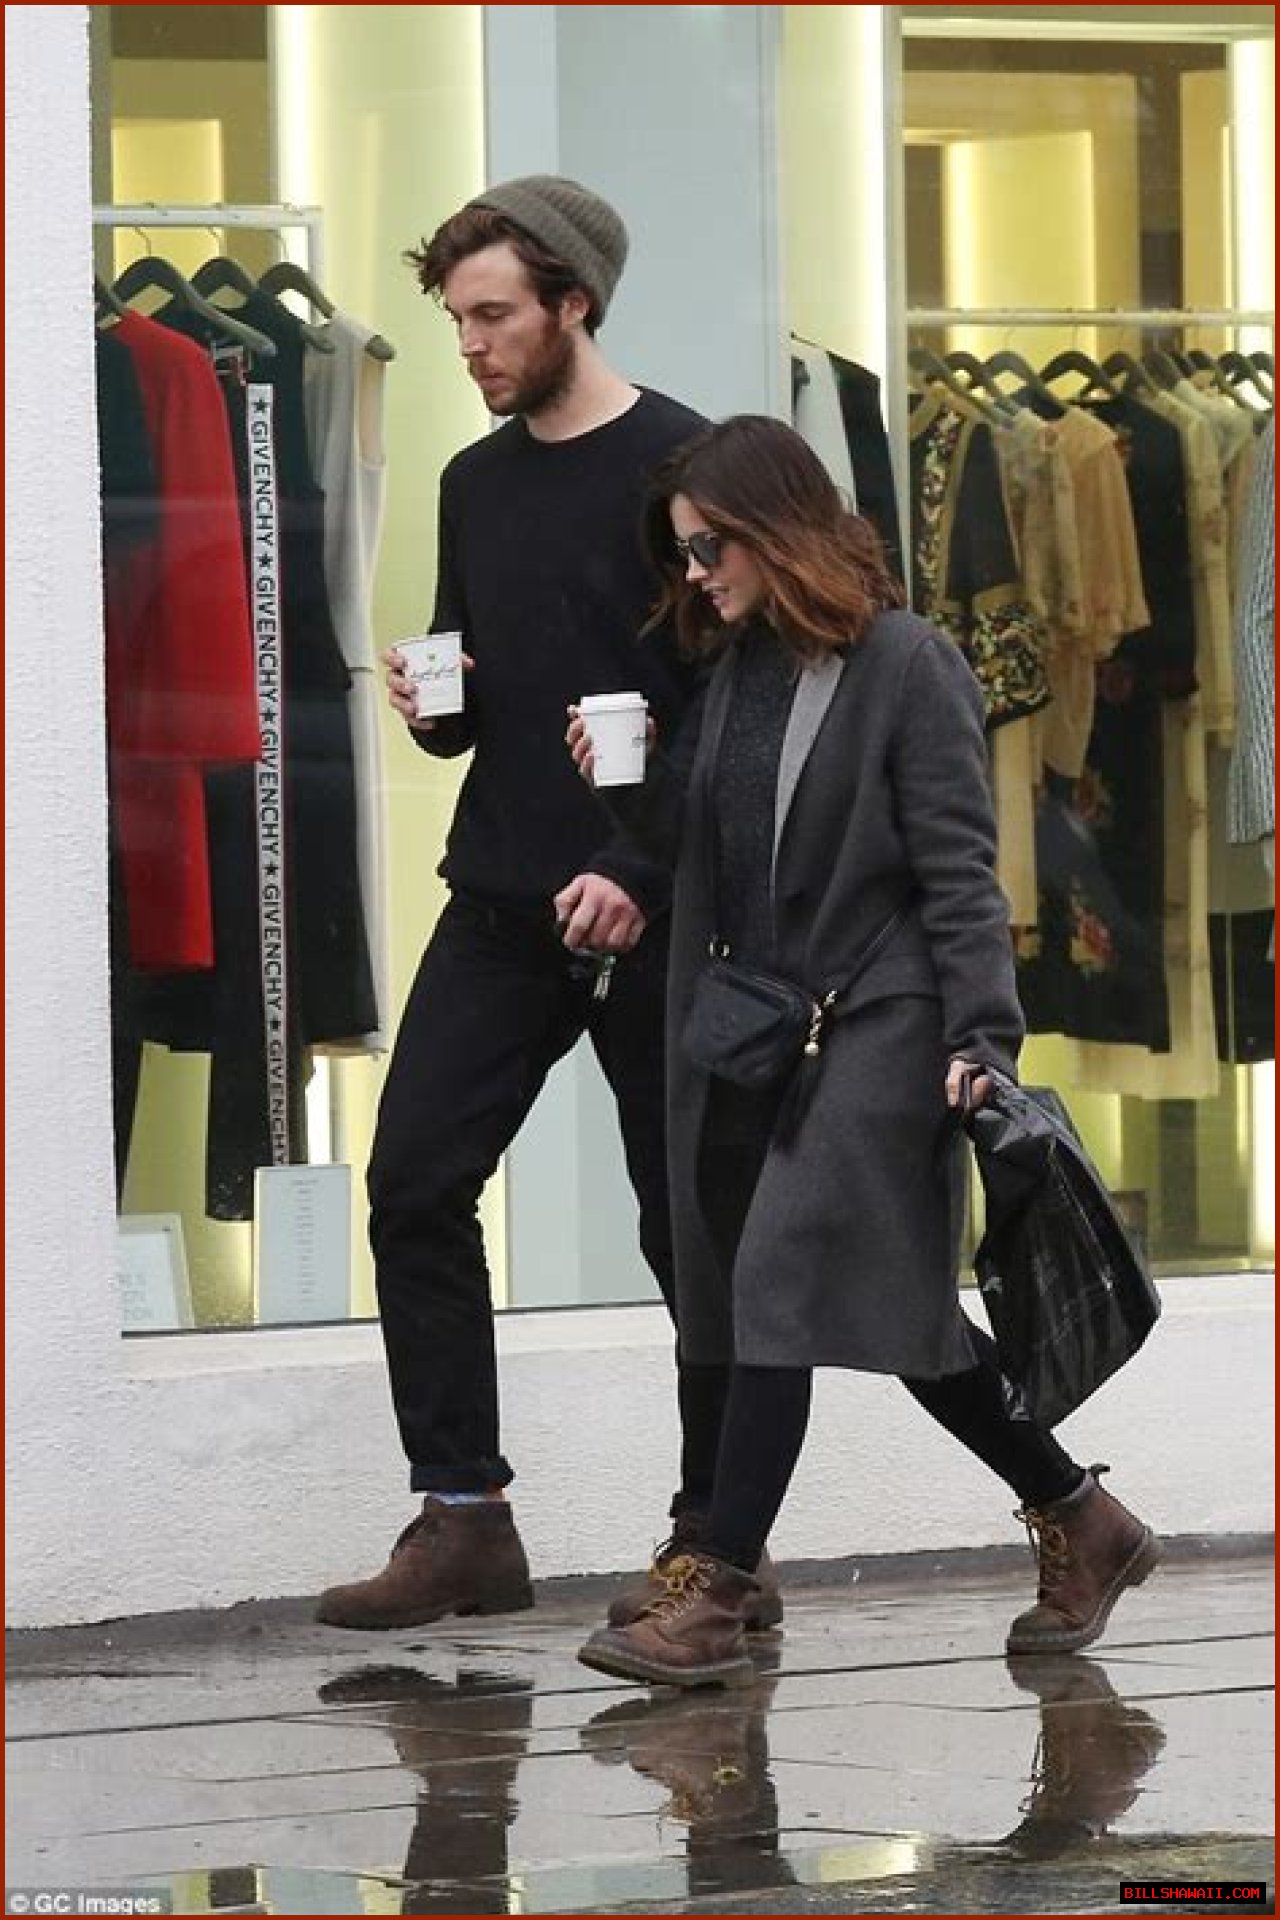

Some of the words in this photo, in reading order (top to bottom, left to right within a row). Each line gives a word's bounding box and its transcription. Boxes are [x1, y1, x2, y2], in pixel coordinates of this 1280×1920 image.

[250, 420, 274, 549] GIVENCHY
[256, 576, 279, 703] GIVENCHY
[260, 728, 280, 855] GIVENCHY
[262, 885, 282, 1011] GIVENCHY
